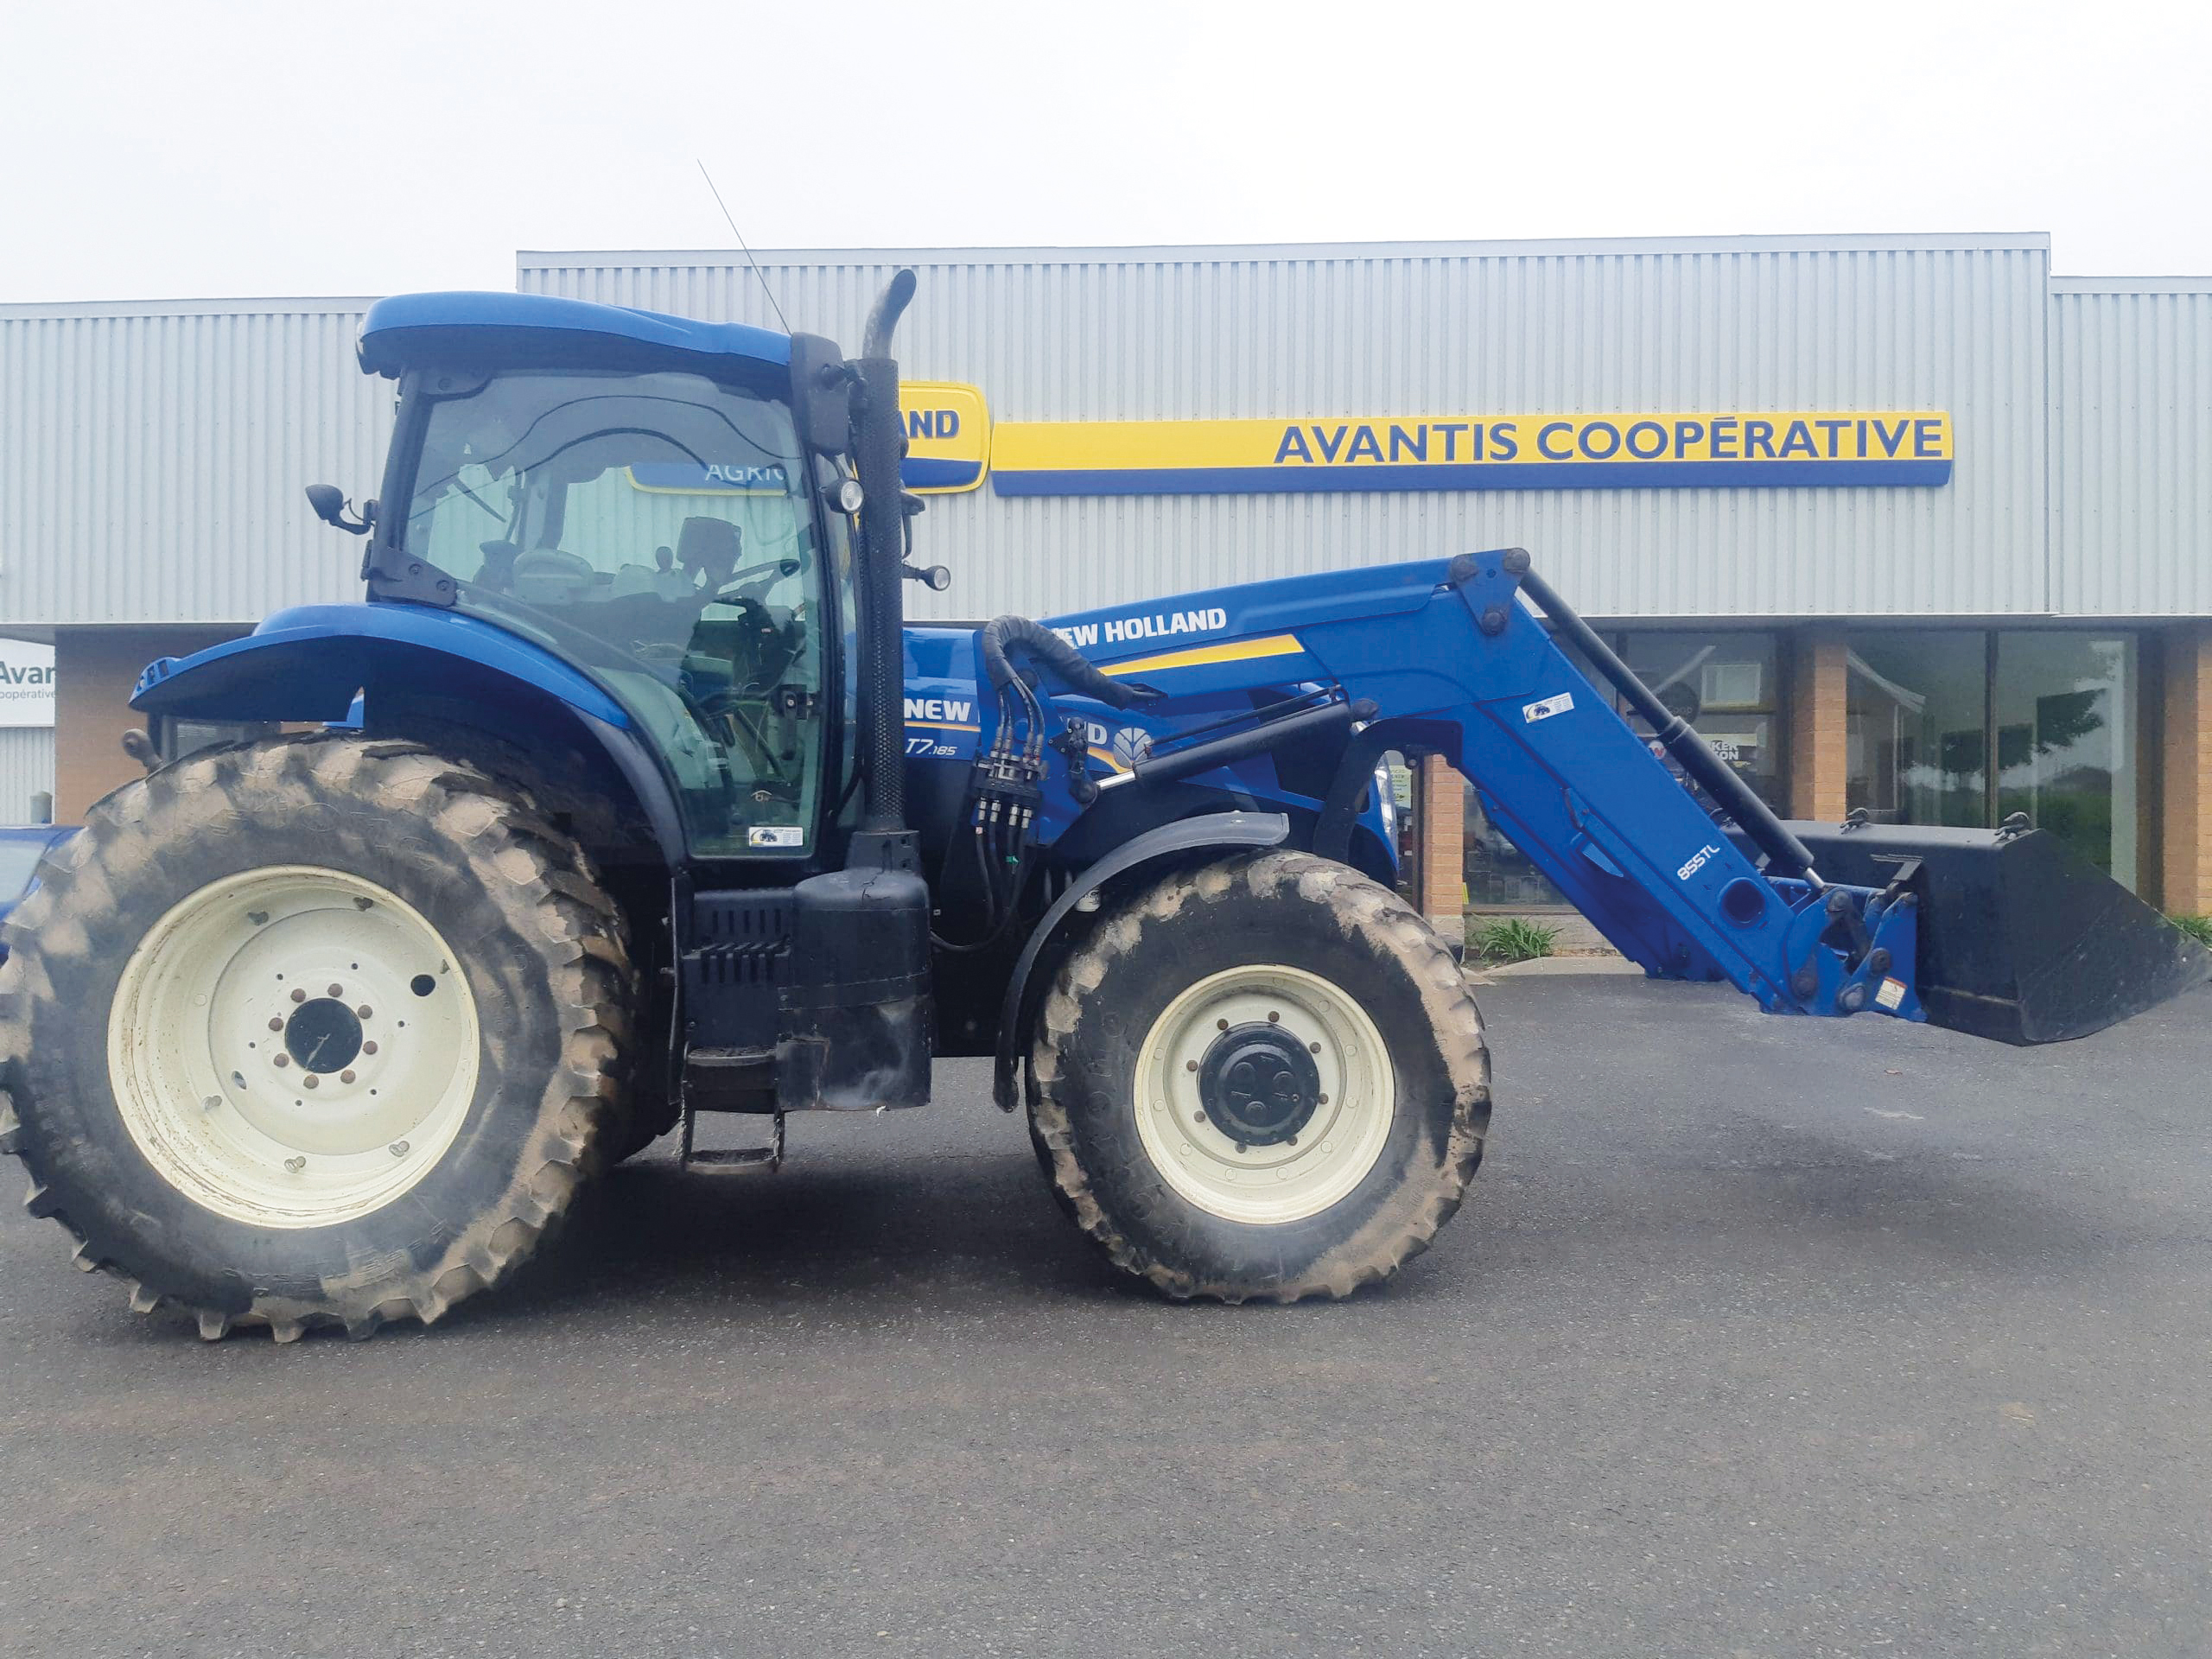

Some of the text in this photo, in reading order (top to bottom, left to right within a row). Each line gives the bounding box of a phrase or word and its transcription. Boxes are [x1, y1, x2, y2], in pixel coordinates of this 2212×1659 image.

[1273, 415, 1942, 464] AVANTIS COOPÉRATIVE
[1103, 607, 1228, 643] HOLLAND
[903, 697, 971, 722] NEW
[905, 737, 958, 756] T7.185
[1676, 844, 1721, 880] 855TL
